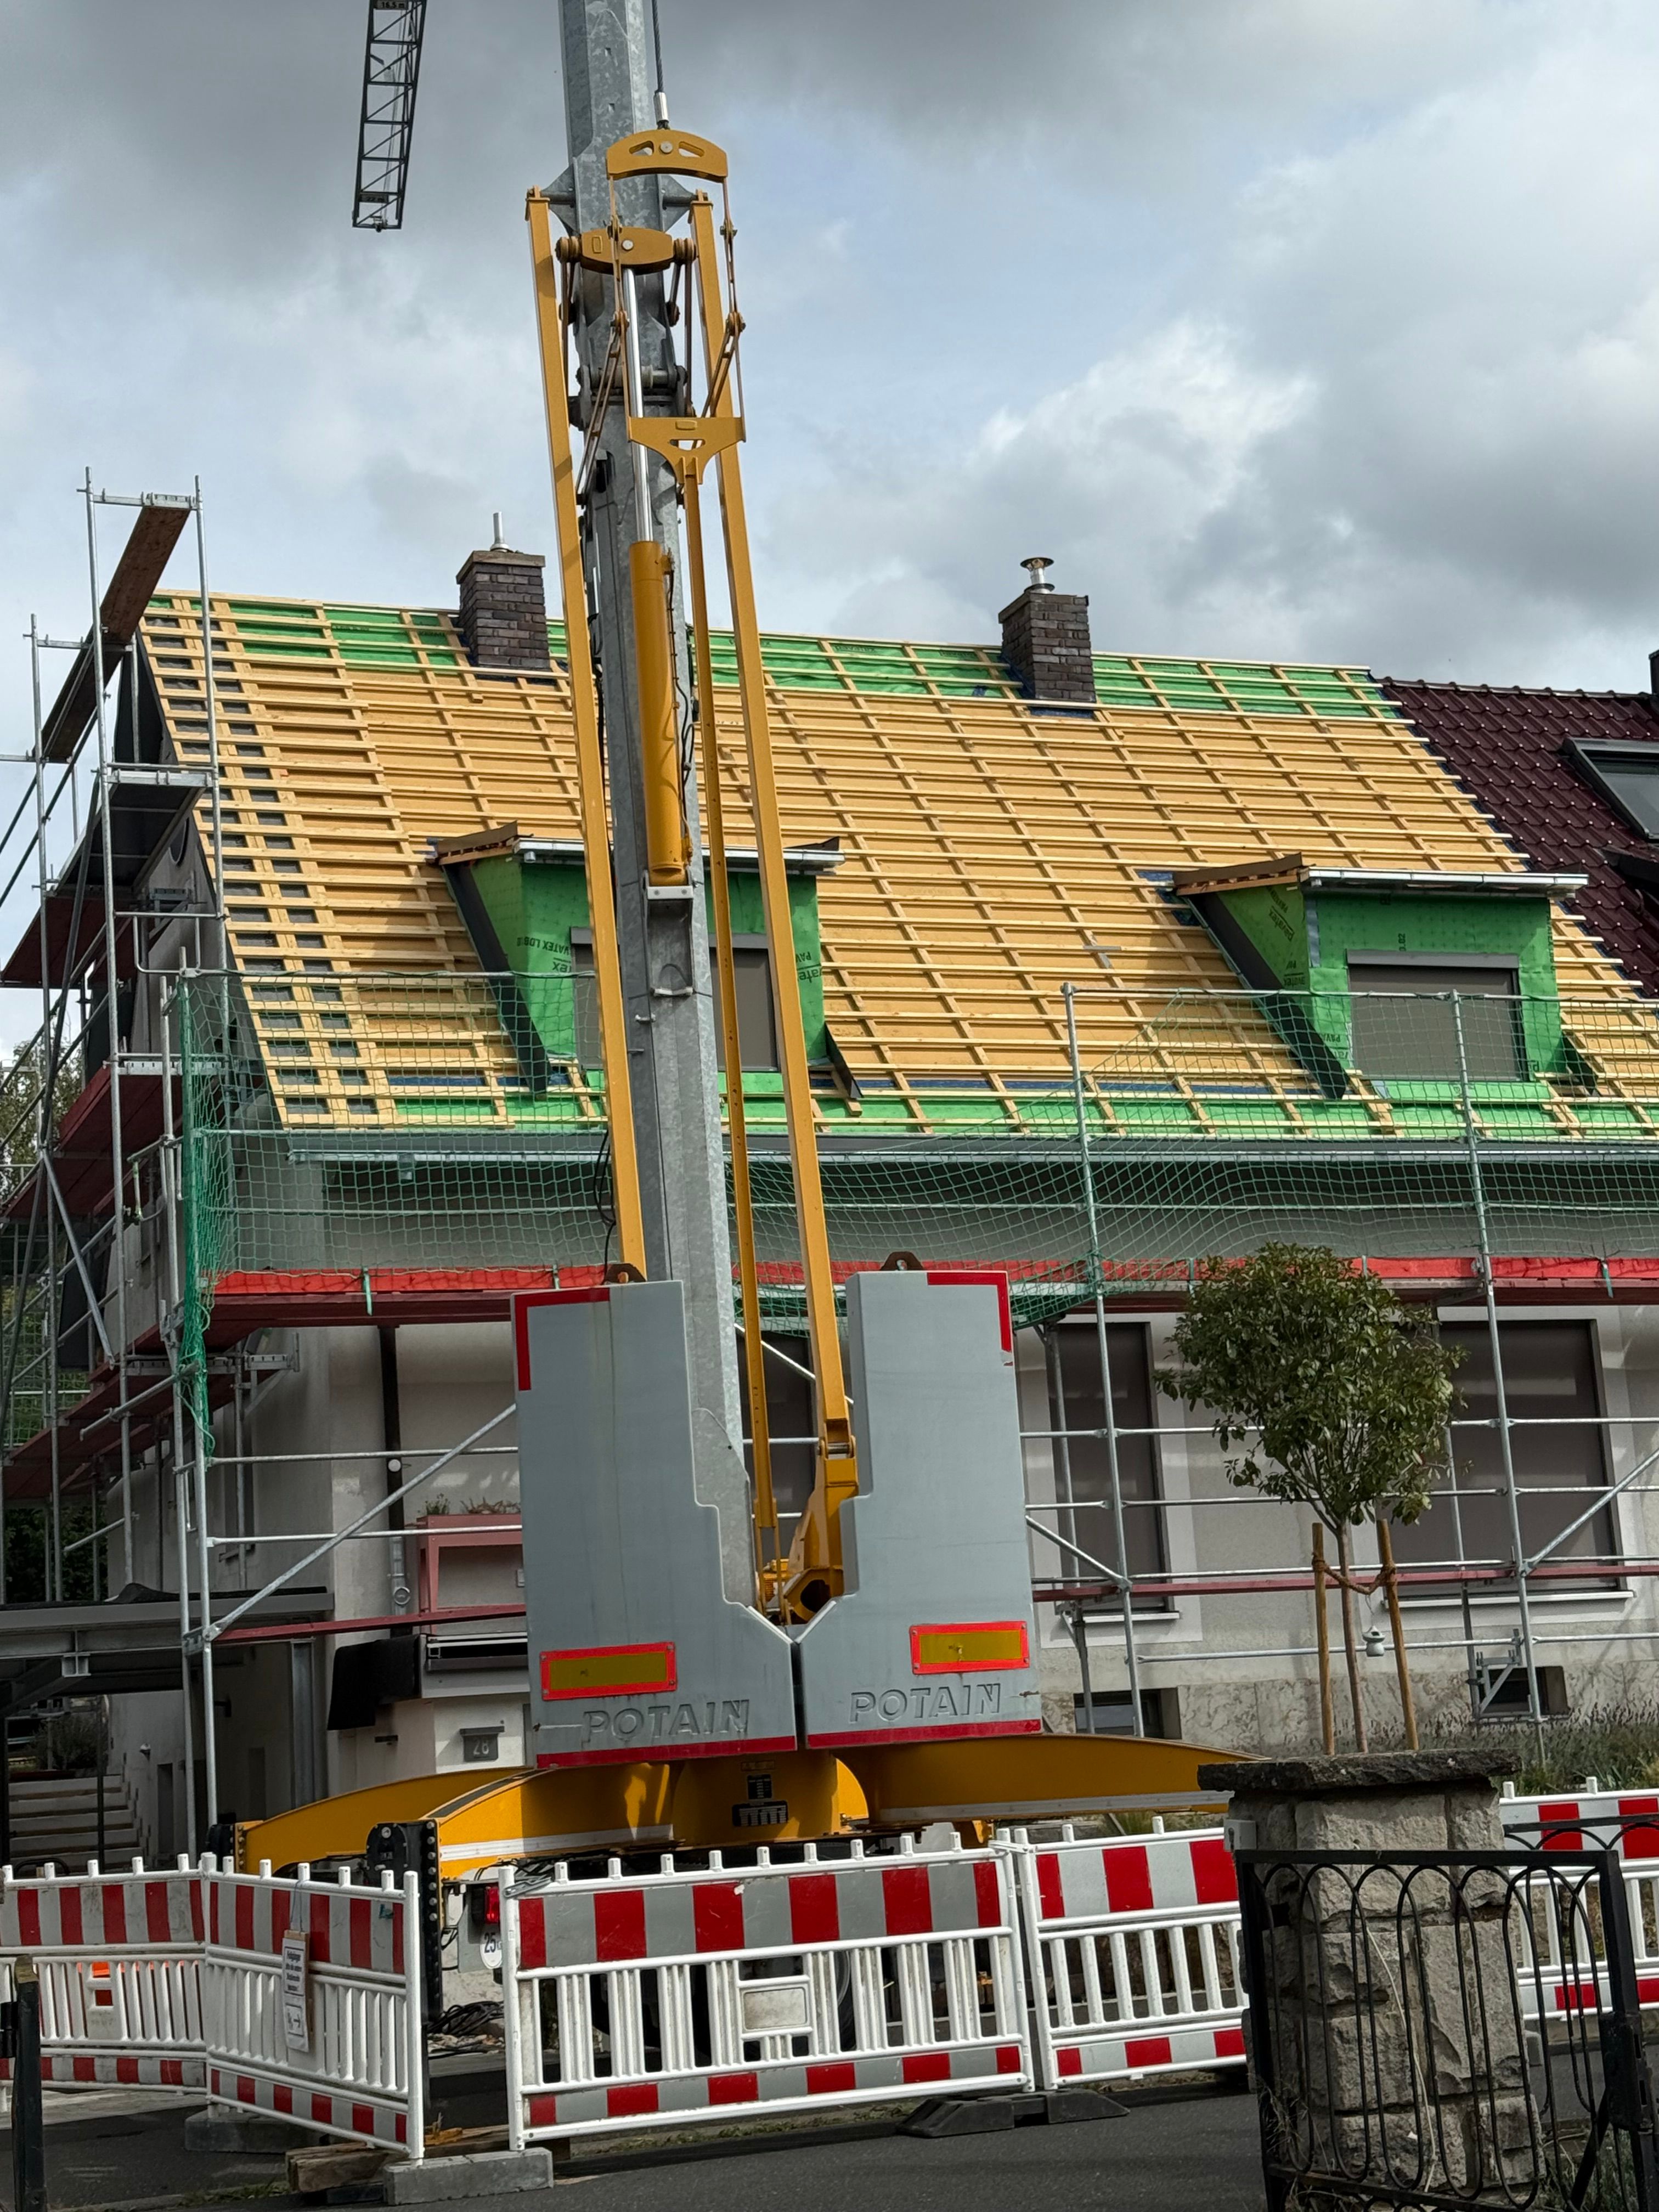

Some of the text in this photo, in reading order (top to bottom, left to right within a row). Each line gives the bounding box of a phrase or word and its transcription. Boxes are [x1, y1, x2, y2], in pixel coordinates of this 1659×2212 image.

[580, 1699, 749, 1743] POTAIN
[849, 1683, 1001, 1724] POTAIN
[484, 1932, 496, 1954] 25
